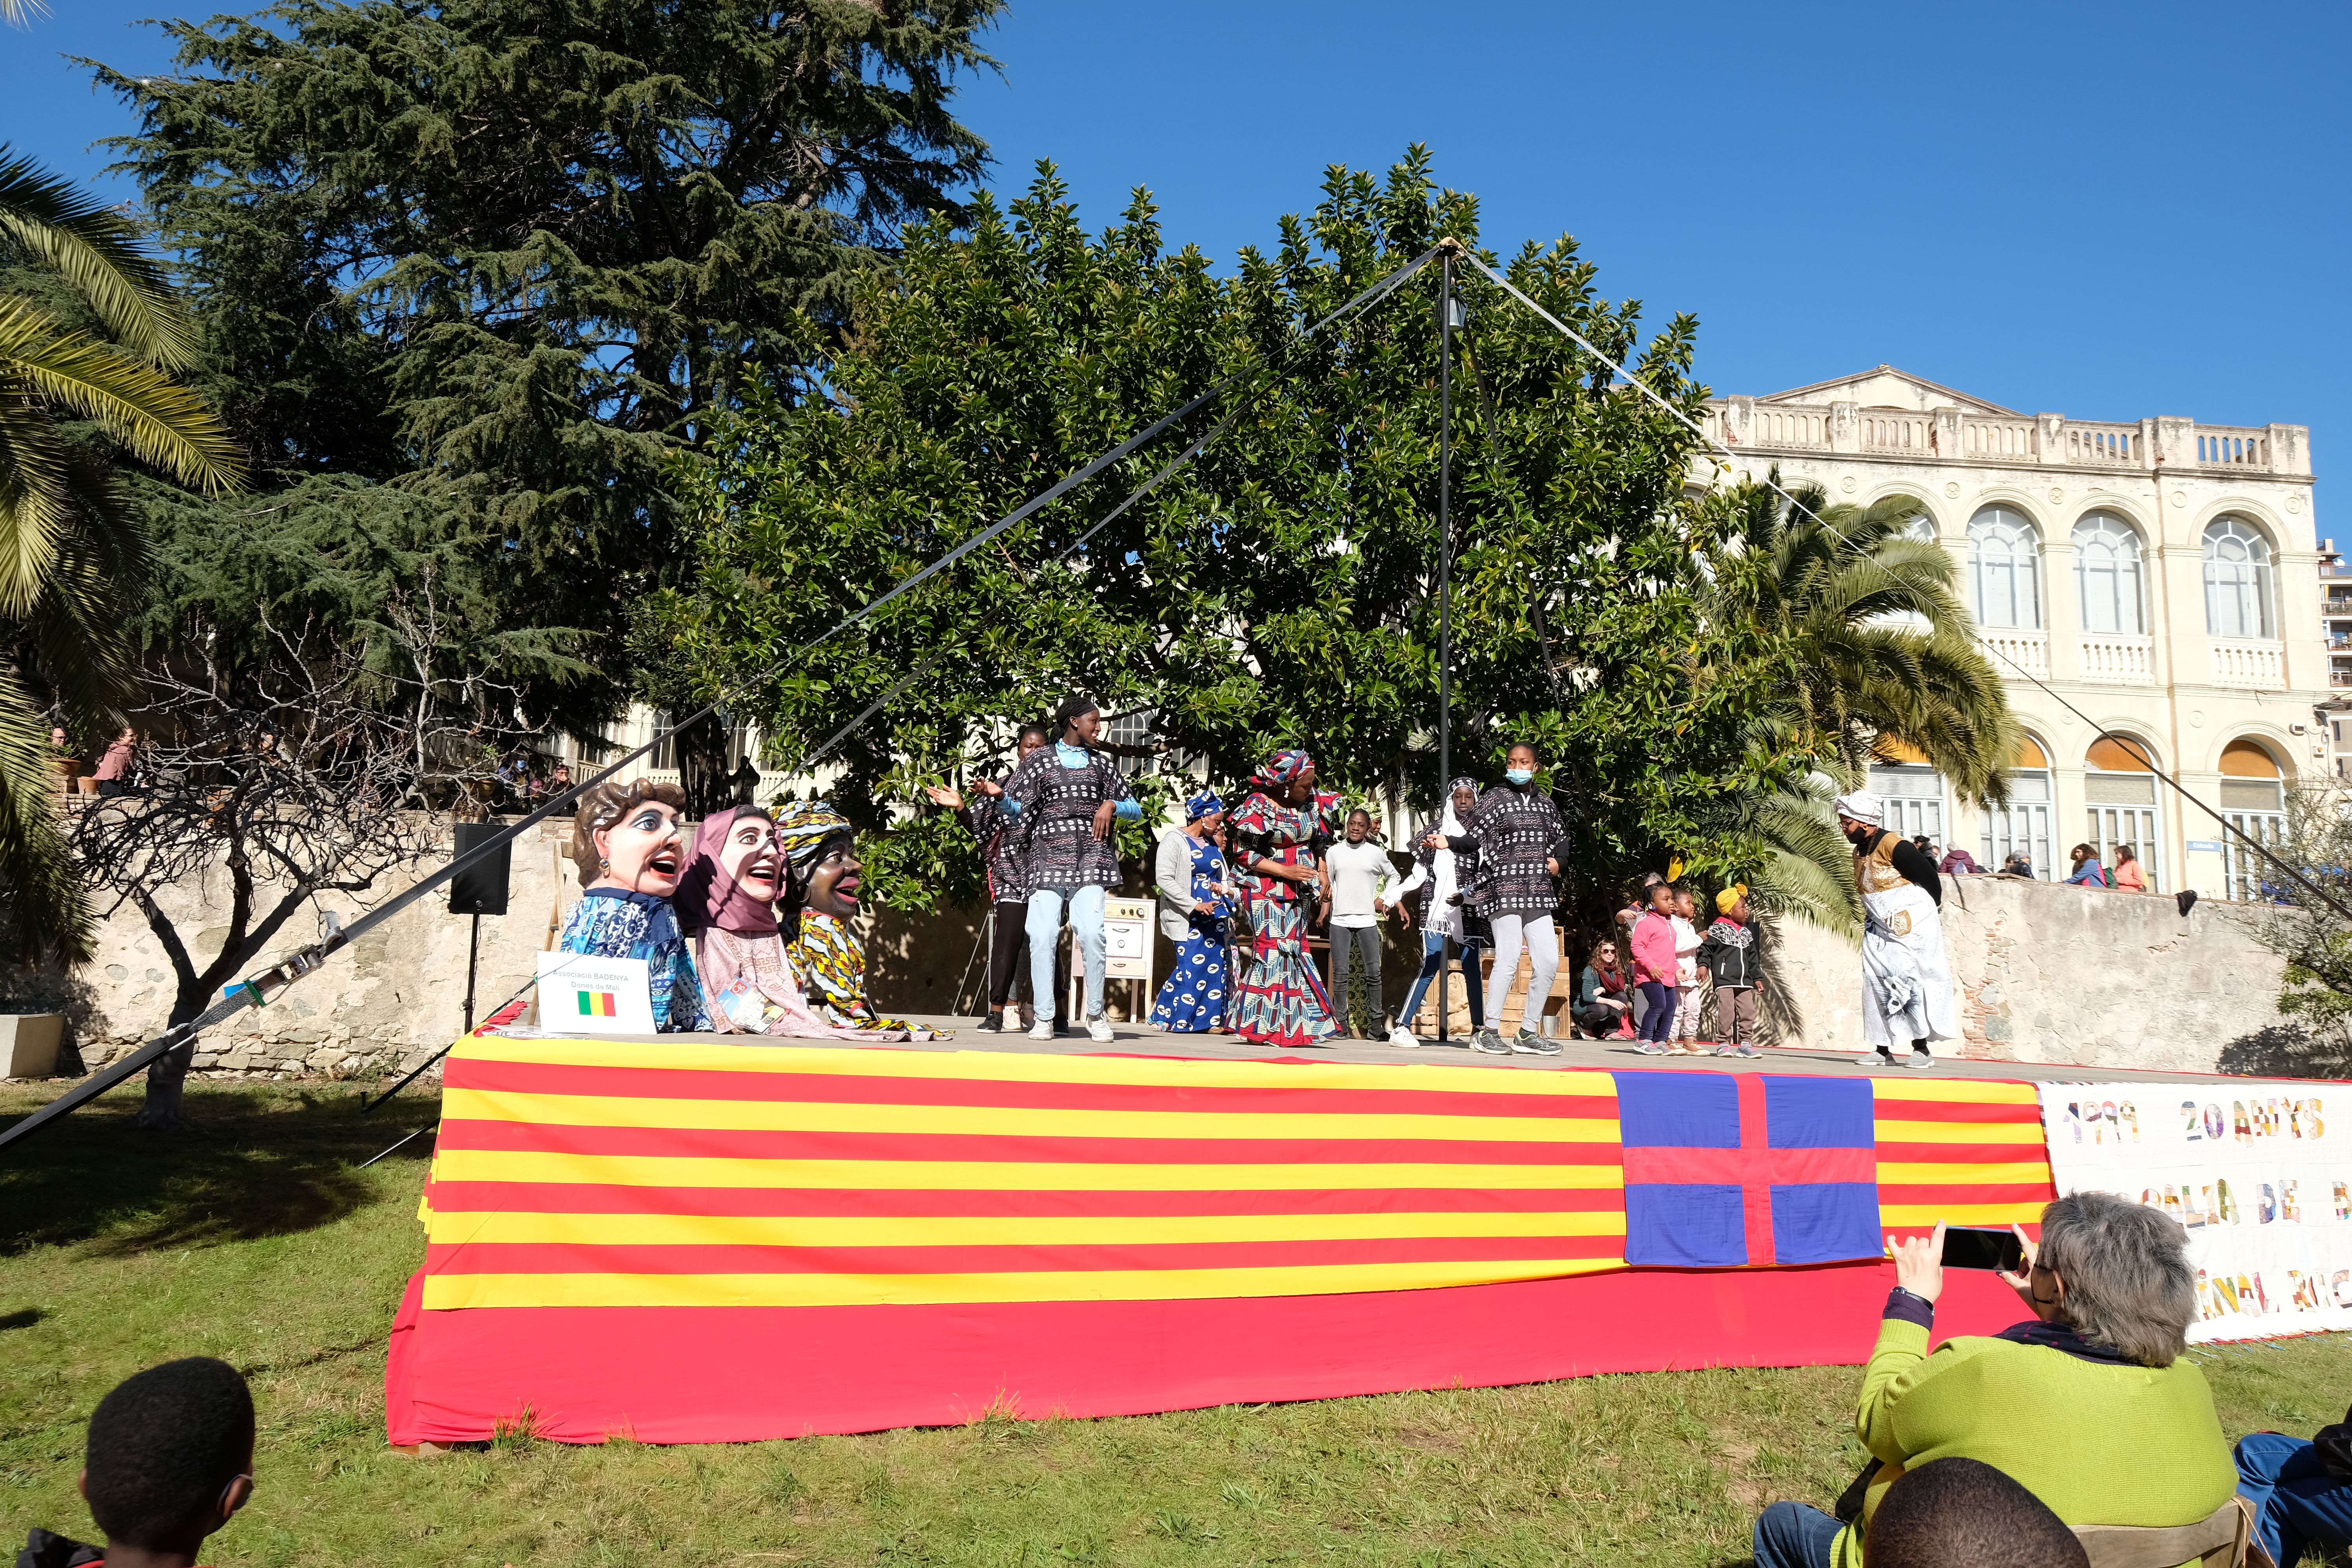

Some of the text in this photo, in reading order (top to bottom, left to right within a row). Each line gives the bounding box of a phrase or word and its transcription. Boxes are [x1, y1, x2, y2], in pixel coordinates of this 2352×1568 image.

[553, 970, 592, 978] Associació
[2063, 1097, 2324, 1147] 1999 20 ANYS
[2257, 1180, 2300, 1224] DE
